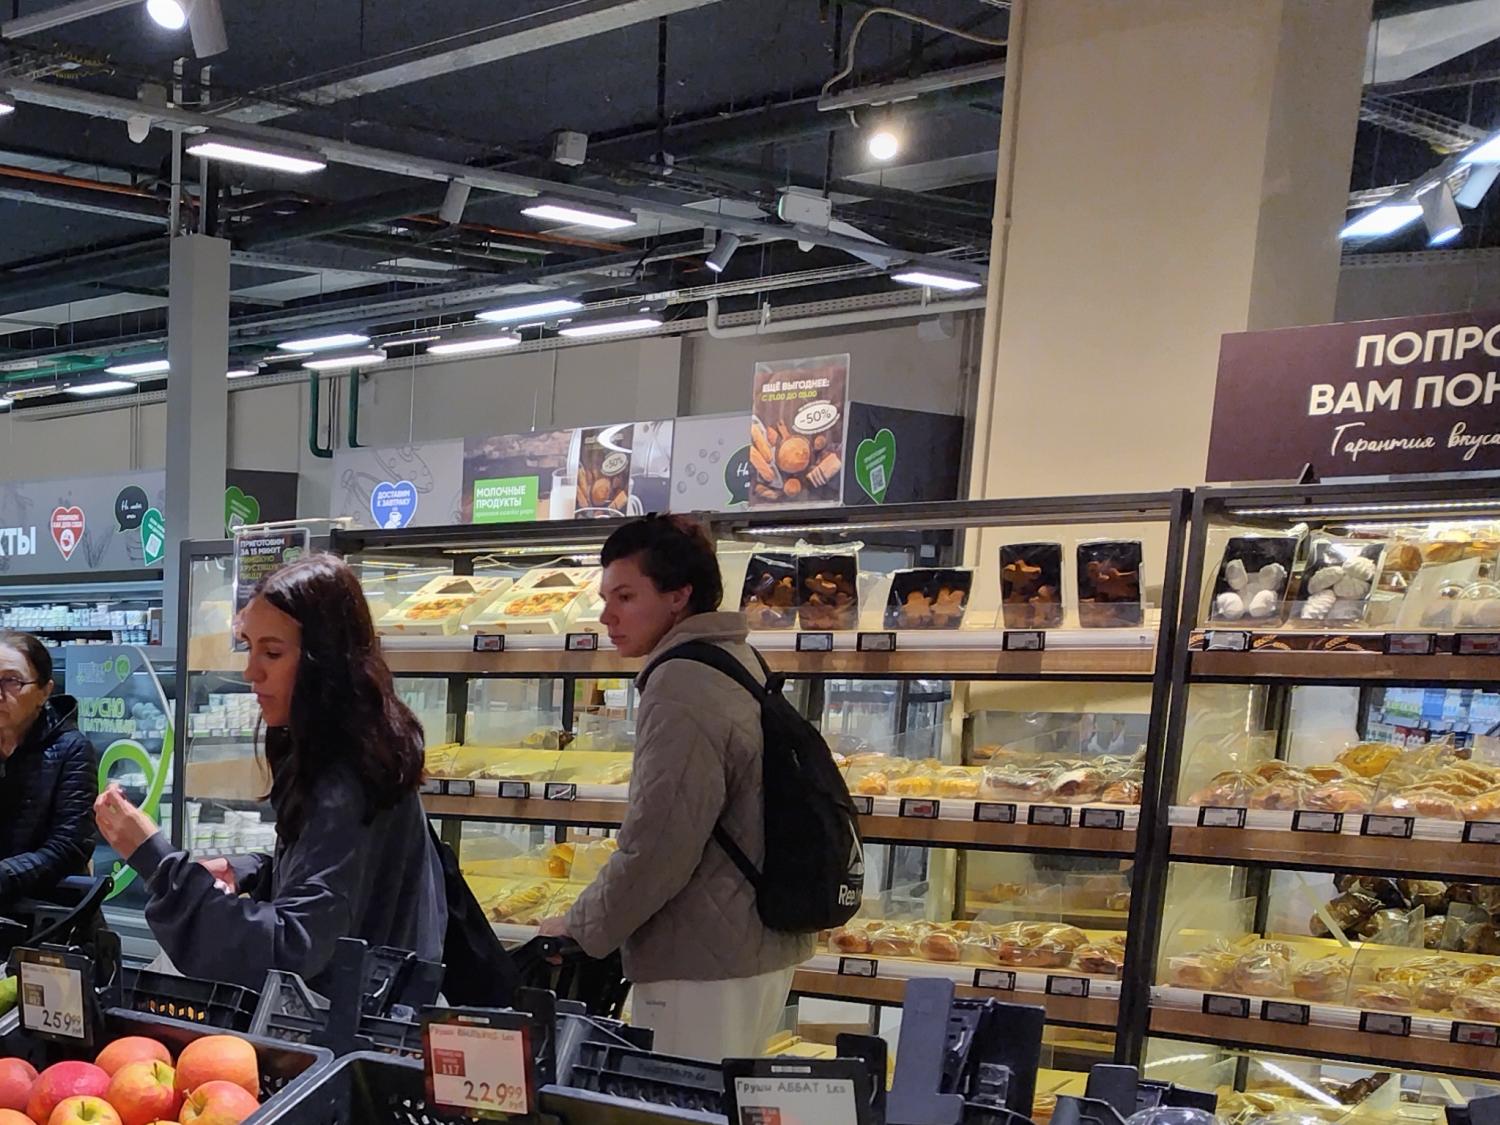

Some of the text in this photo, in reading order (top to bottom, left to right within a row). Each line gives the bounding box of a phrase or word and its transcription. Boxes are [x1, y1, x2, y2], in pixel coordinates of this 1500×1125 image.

[762, 378, 830, 393] ЕЩЁ ВЫГОДНЕЕ:
[786, 392, 797, 400] ДО
[1308, 378, 1403, 416] ВАМ
[800, 408, 832, 425] -50%
[1331, 421, 1436, 462] Гарантия
[476, 485, 526, 498] МОЛОЧНЫЕ
[475, 497, 521, 510] ПРОДУКТЫ
[42, 1009, 72, 1032] 259
[442, 1064, 459, 1075] 117
[464, 1080, 522, 1106] 229 99
[737, 1081, 772, 1094] Груши
[778, 1082, 819, 1093] АББАТ
